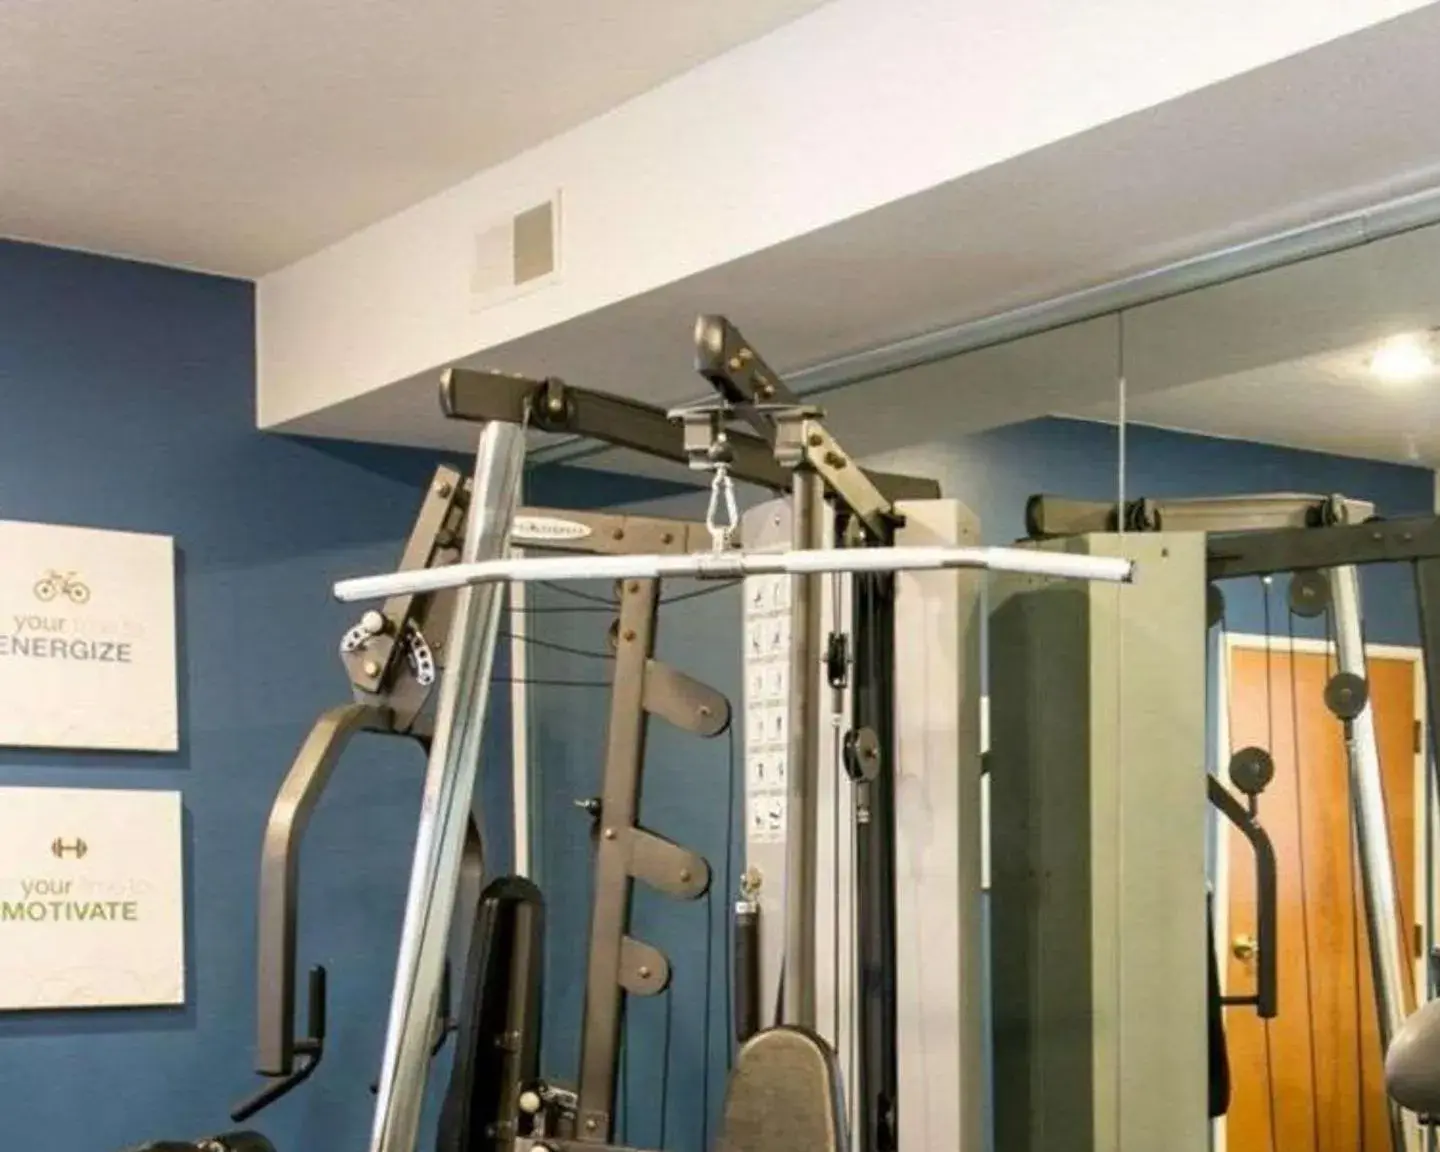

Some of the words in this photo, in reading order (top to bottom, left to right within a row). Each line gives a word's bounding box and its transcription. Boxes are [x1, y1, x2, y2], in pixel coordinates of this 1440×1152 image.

[13, 613, 67, 635] your
[20, 876, 73, 900] your
[1, 900, 139, 923] MOTIVATE
